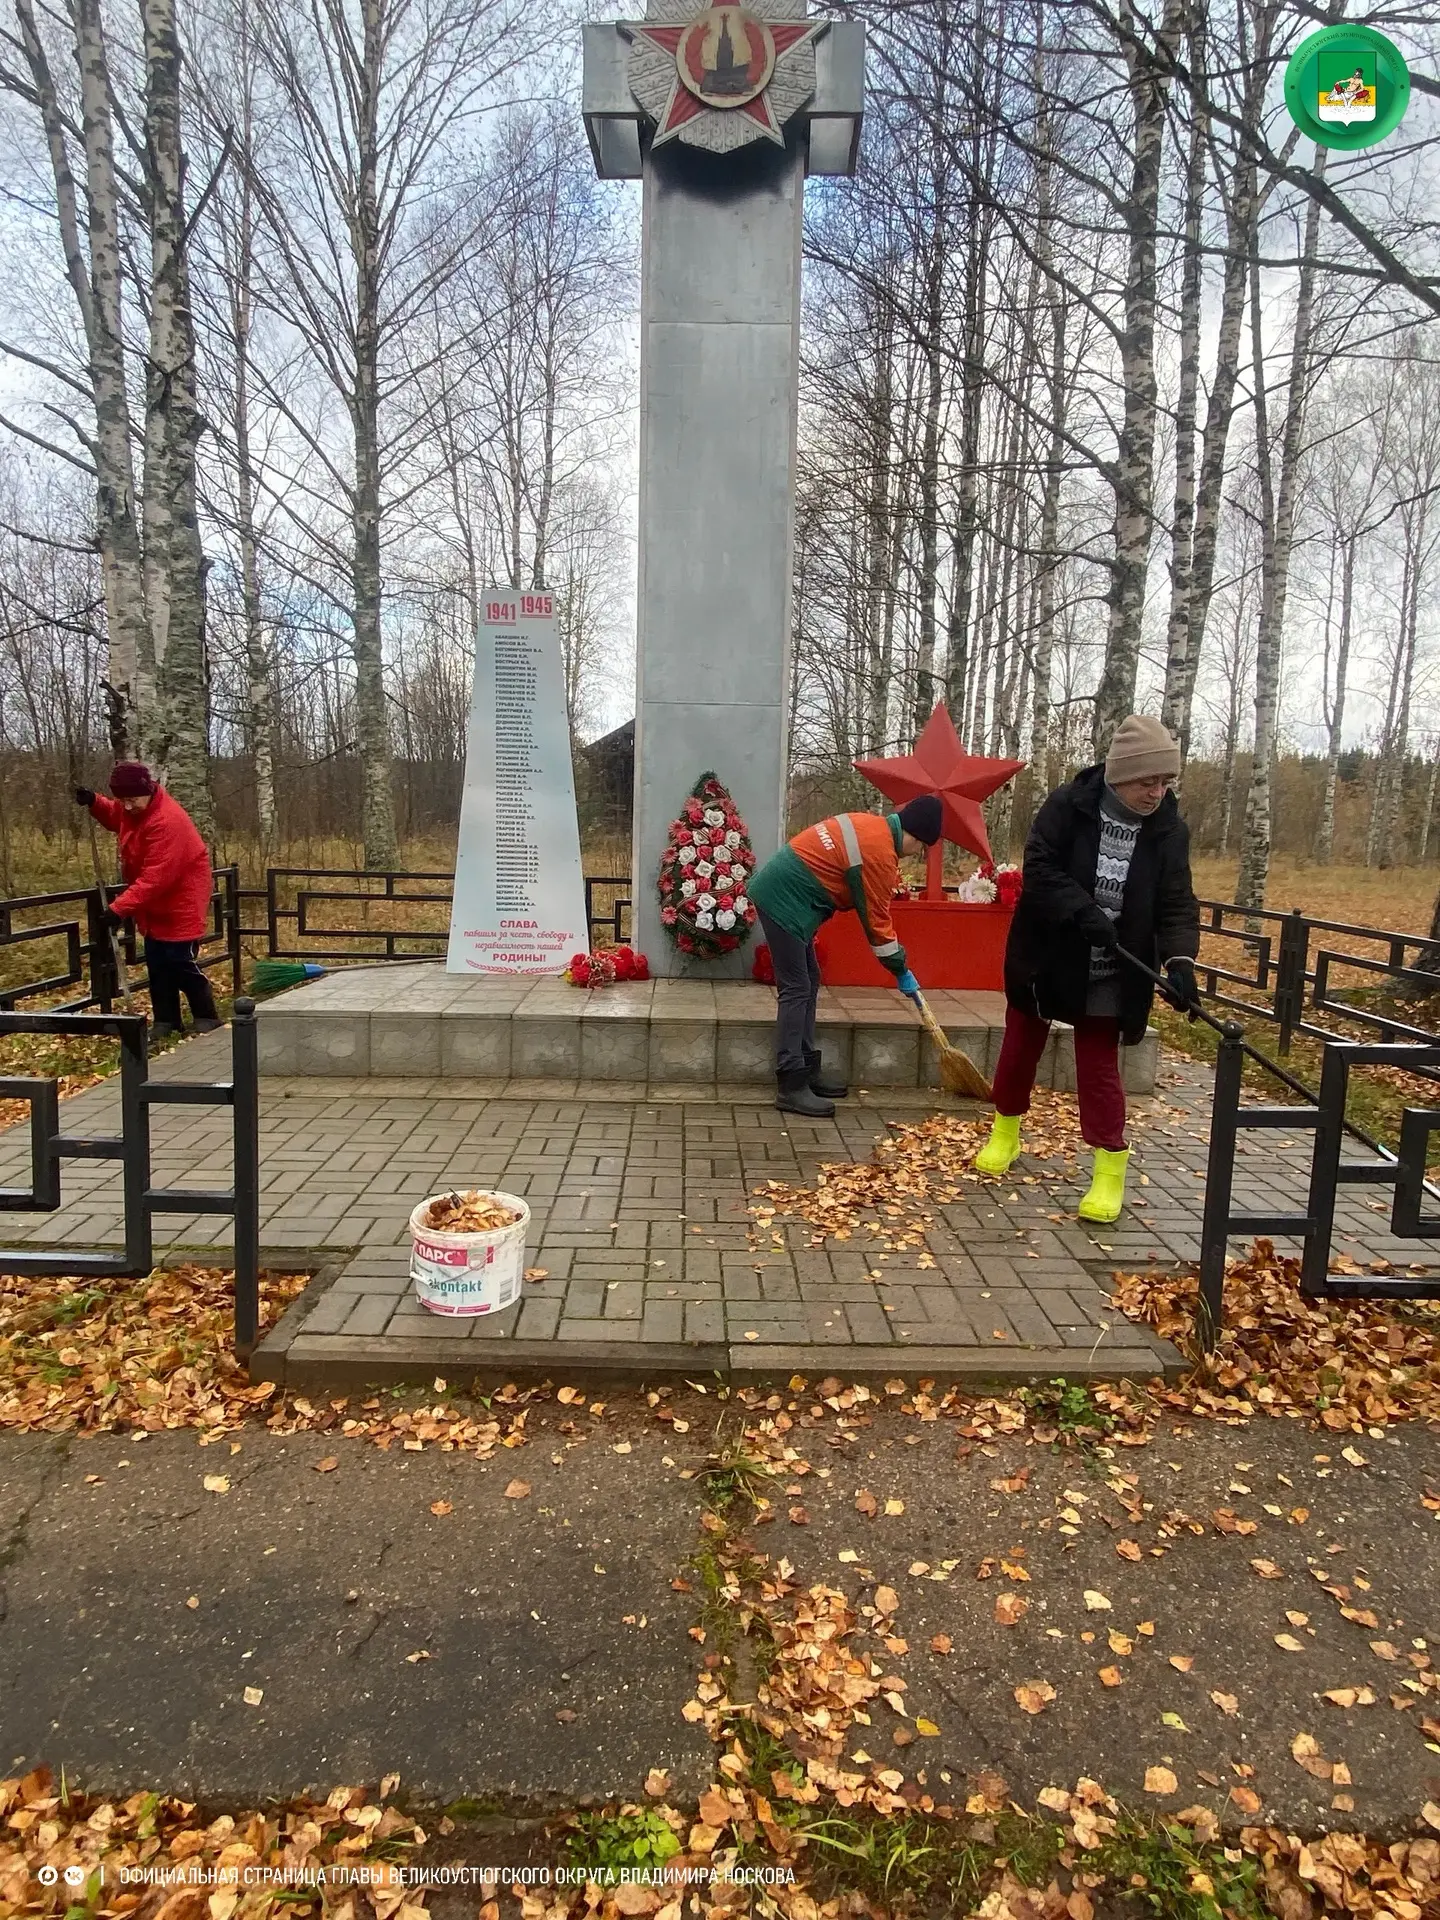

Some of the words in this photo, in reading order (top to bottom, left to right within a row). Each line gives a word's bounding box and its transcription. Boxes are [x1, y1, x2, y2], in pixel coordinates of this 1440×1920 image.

[486, 602, 516, 620] 1941
[520, 596, 552, 614] 1945
[500, 920, 538, 928] СЛАВА
[464, 930, 497, 938] павшим
[498, 931, 510, 941] за
[537, 931, 567, 942] свободу
[475, 941, 535, 952] независимость
[537, 943, 563, 951] нашей
[492, 953, 546, 962] РОДИНЫ!
